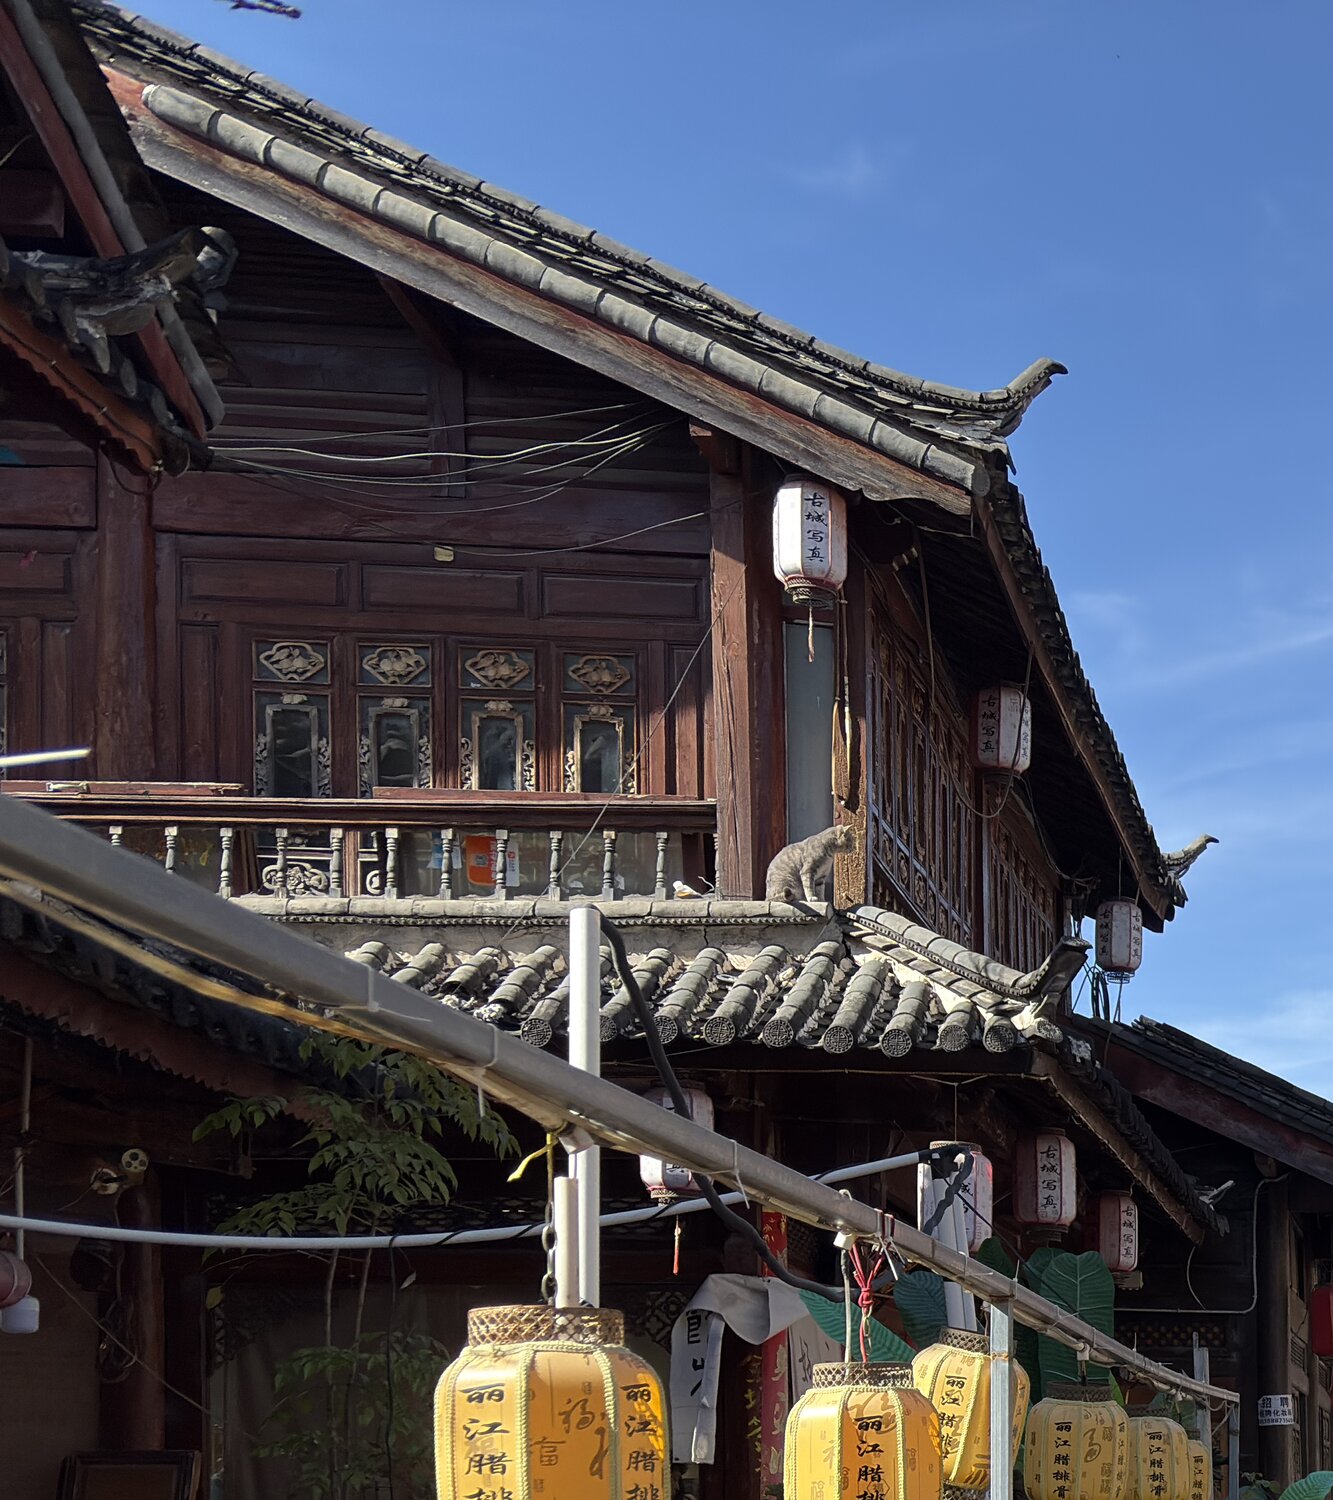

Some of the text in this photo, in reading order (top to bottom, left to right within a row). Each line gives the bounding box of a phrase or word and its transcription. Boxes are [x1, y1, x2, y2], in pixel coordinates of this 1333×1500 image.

[804, 492, 828, 562] 古城写真
[1040, 1145, 1061, 1209] 古城写真
[1122, 1206, 1136, 1259] 古城写真
[1052, 1421, 1073, 1499] 丽江腊排骨
[1147, 1431, 1164, 1498] 丽江腊排骨
